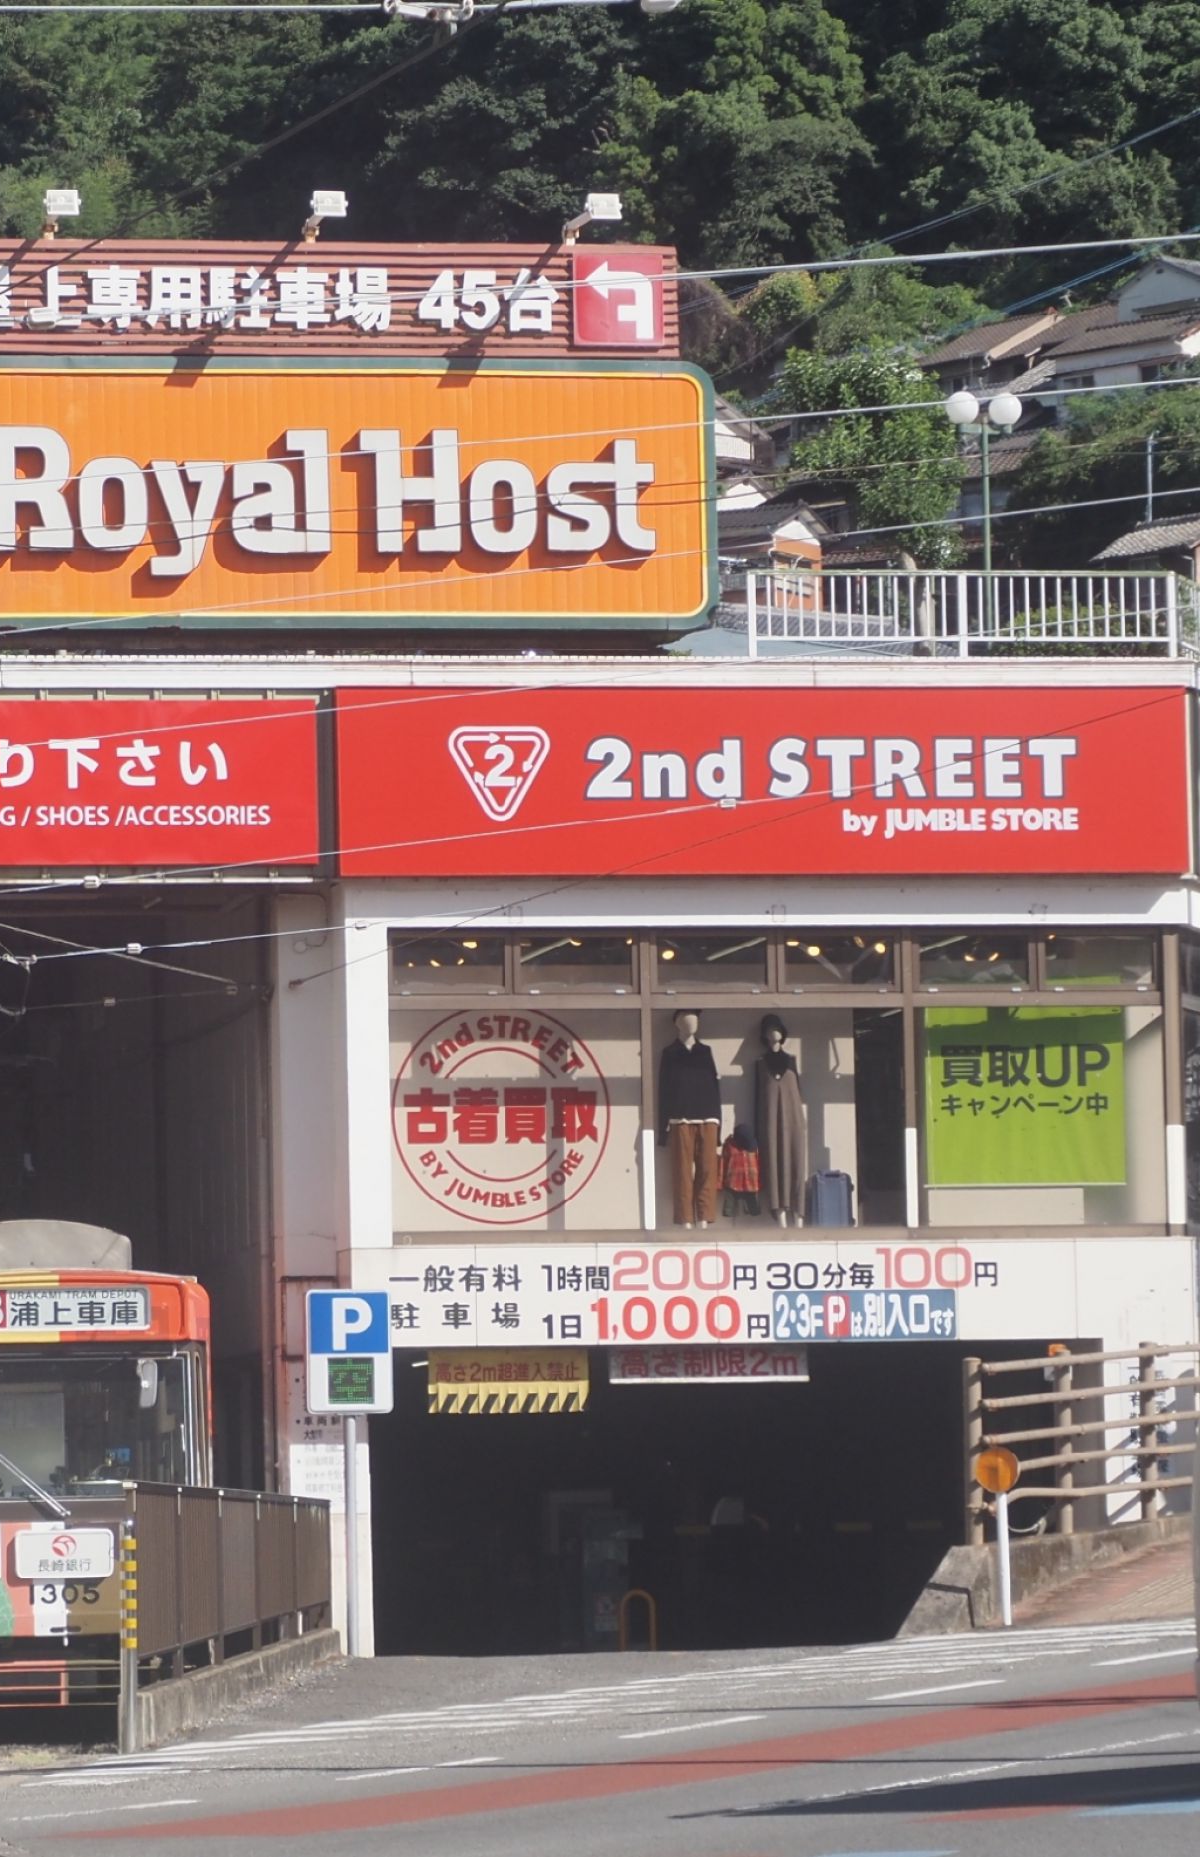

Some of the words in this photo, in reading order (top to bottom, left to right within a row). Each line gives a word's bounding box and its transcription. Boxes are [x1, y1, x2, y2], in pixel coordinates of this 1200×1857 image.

[417, 267, 561, 334] 45台
[359, 428, 657, 554] Host
[586, 737, 742, 799] 2nd
[767, 736, 1078, 799] STREET
[36, 805, 110, 827] SHOES
[843, 809, 879, 833] by
[884, 808, 987, 838] JUMBLE
[991, 806, 1079, 832] STORE
[419, 1022, 475, 1076] 2nd
[476, 1014, 585, 1074] STREET
[940, 1043, 1111, 1088] 買取UP
[403, 1086, 598, 1145] 古着買取
[940, 1092, 1109, 1117] キャンペーン中
[419, 1149, 449, 1180] BY
[444, 1177, 527, 1208] JUMBLE
[528, 1148, 585, 1202] STORE
[389, 1264, 522, 1292] 一般有料
[9, 1289, 62, 1300] URAKAMI
[65, 1289, 98, 1300] TRAM
[101, 1289, 139, 1300] DEPOT
[10, 1300, 139, 1327] 浦上車庫
[331, 1297, 372, 1351] P
[390, 1302, 521, 1330] 駐車場
[435, 1361, 581, 1382] 高さ2m超進入禁止
[620, 1347, 799, 1378] 高さ制限2m
[38, 1559, 92, 1572] 長崎銀行
[29, 1584, 100, 1605] 1305
